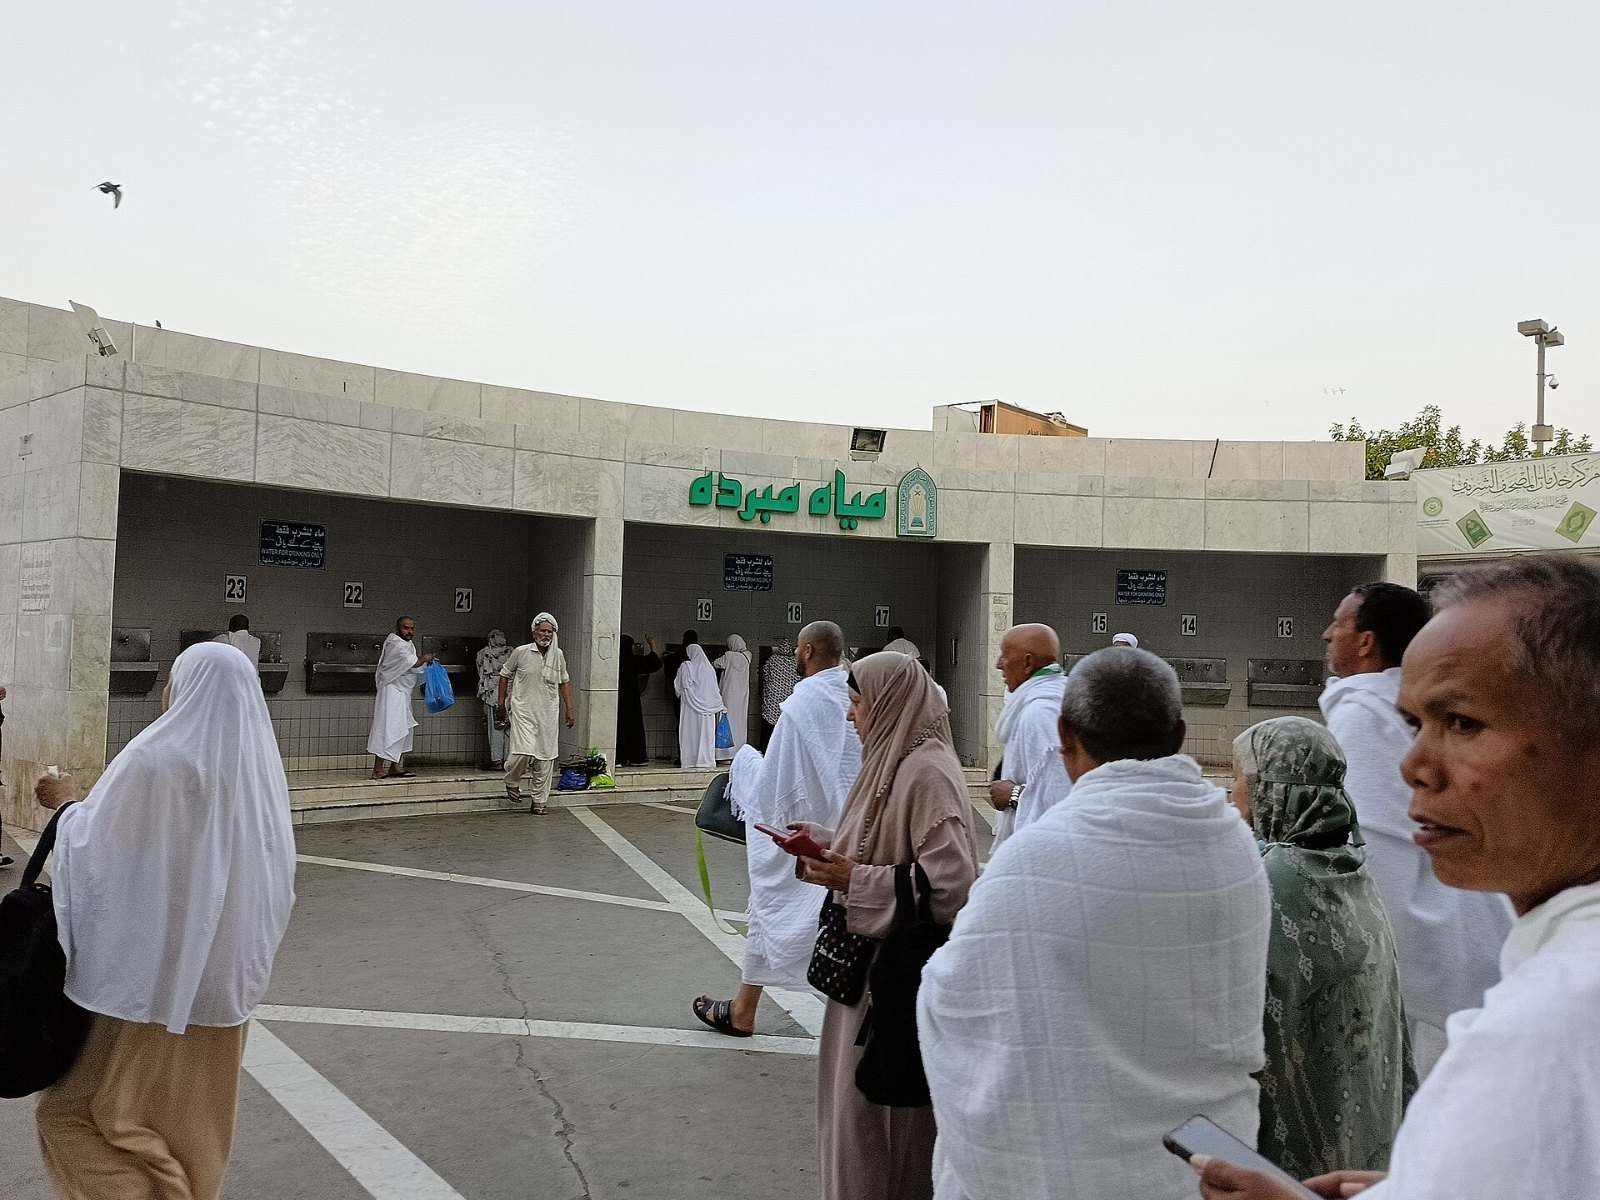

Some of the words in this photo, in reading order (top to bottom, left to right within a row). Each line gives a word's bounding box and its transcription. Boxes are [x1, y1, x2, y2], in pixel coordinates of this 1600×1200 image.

[689, 470, 801, 524] مبرده
[808, 468, 887, 530] مياه
[227, 578, 245, 599] 23
[345, 584, 362, 604] 22
[456, 591, 471, 610] 21
[699, 602, 711, 619] 19
[789, 604, 801, 621] 18
[877, 609, 889, 625] 17
[1094, 615, 1106, 631] 15
[1182, 617, 1196, 634] 14
[1279, 619, 1292, 636] 13
